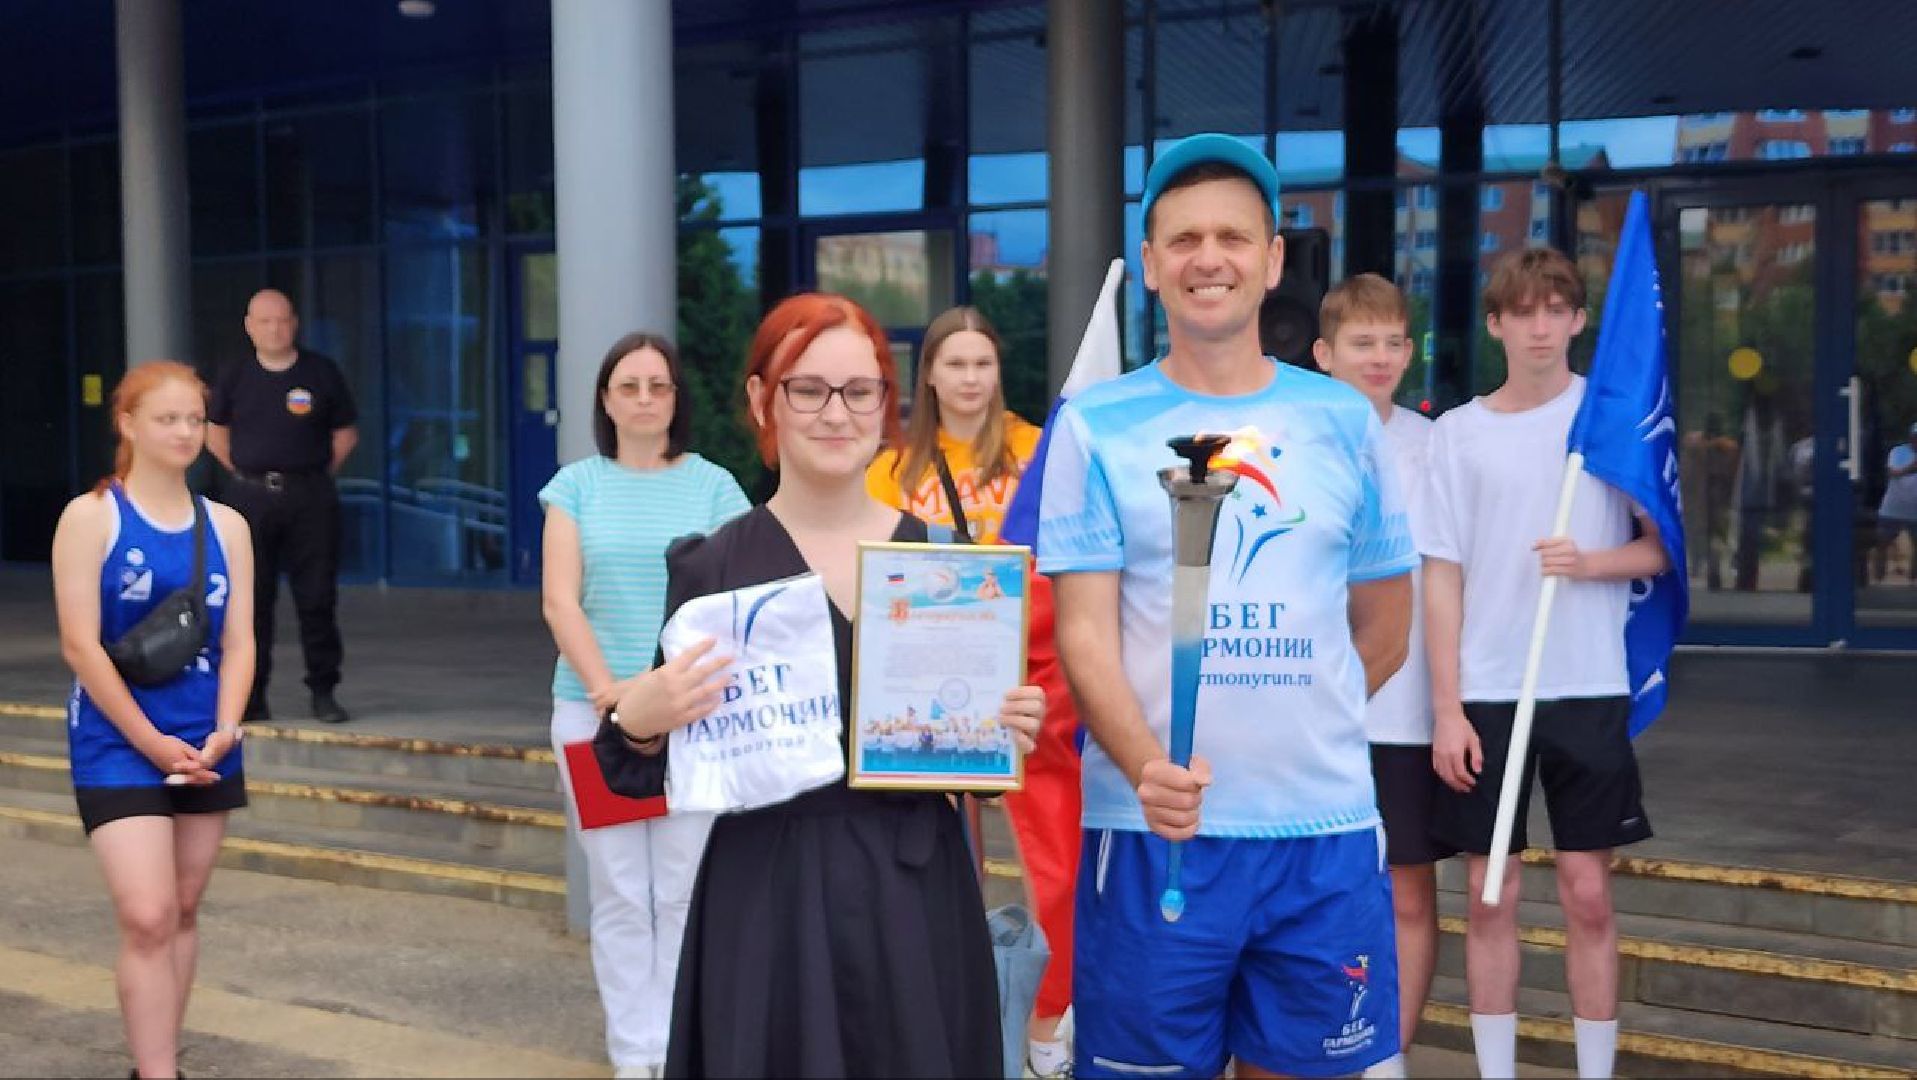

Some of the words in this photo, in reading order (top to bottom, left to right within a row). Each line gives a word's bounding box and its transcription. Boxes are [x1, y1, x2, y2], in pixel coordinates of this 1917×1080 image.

[206, 573, 227, 606] 2
[1210, 602, 1287, 630] БЕГ
[1201, 637, 1313, 658] РМОНИИ
[723, 663, 793, 703] БЕГ
[1199, 671, 1313, 690] rmonyrun.ru
